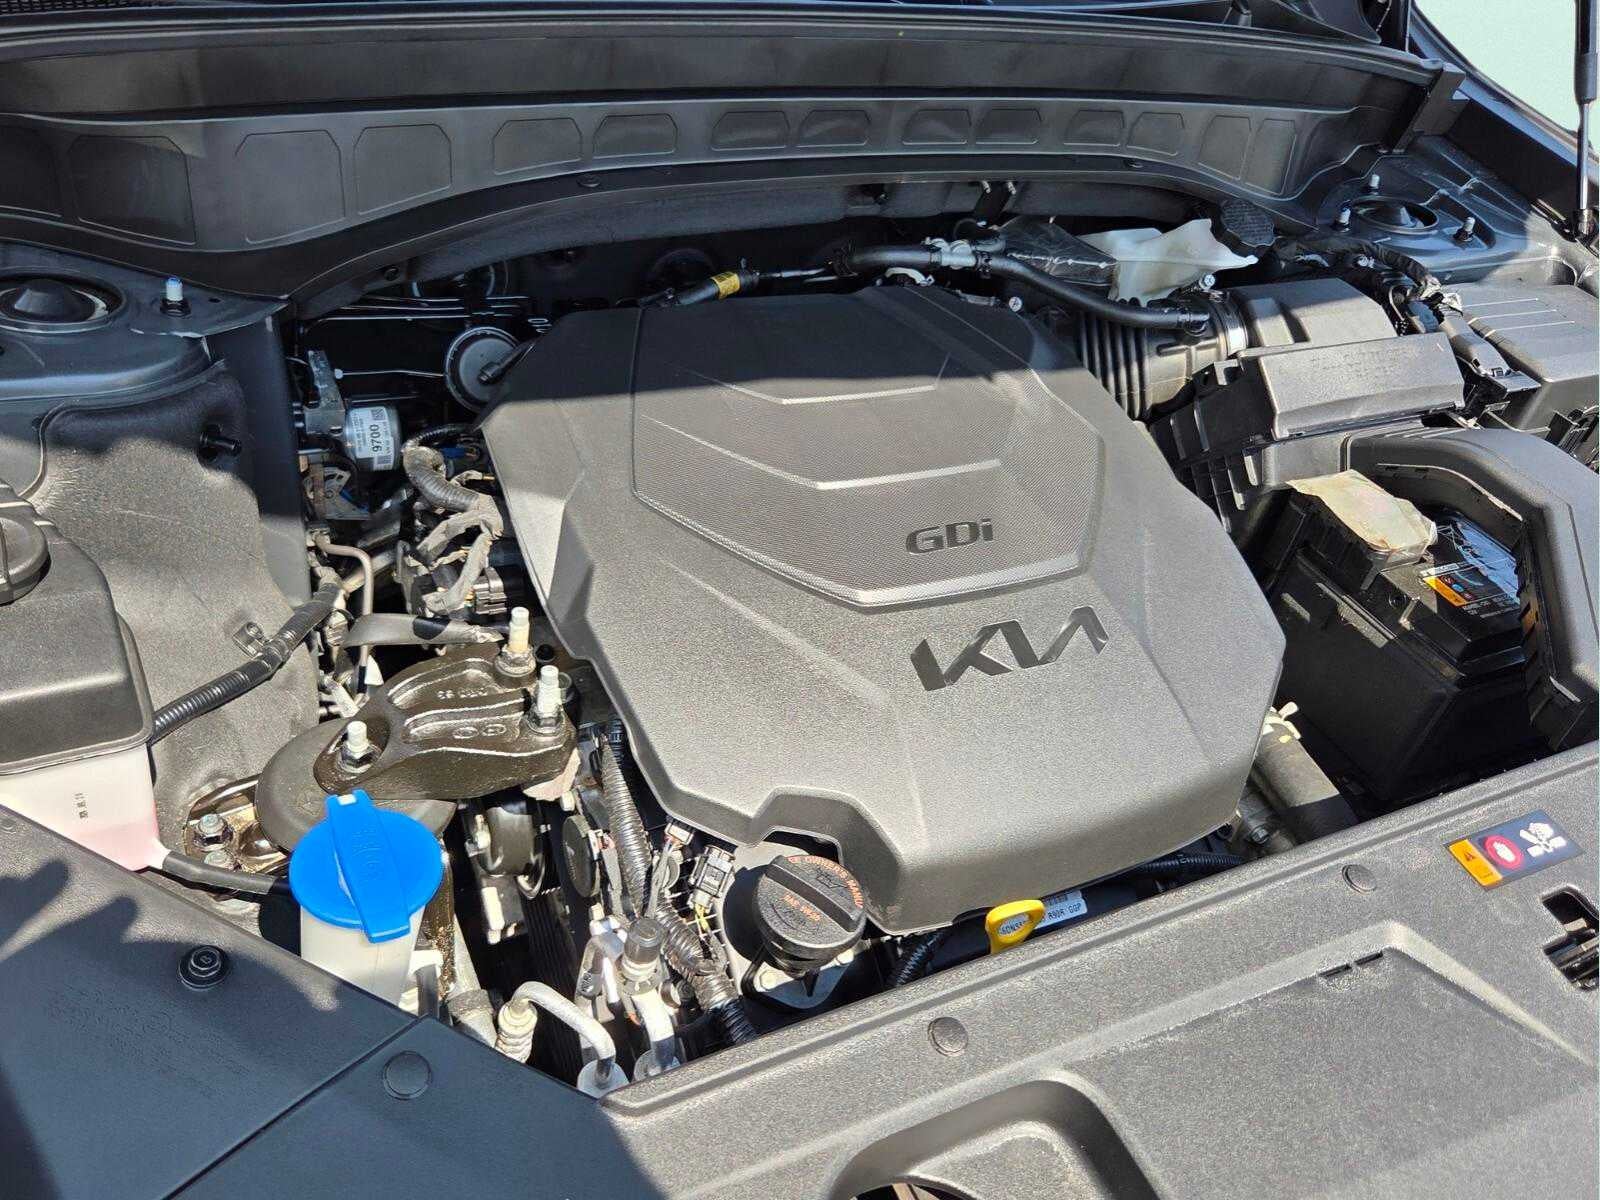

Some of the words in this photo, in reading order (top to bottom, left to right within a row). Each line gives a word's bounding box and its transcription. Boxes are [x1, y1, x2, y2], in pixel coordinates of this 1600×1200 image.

[369, 424, 382, 453] 9700
[905, 518, 993, 554] GDi
[909, 605, 1109, 691] KIA
